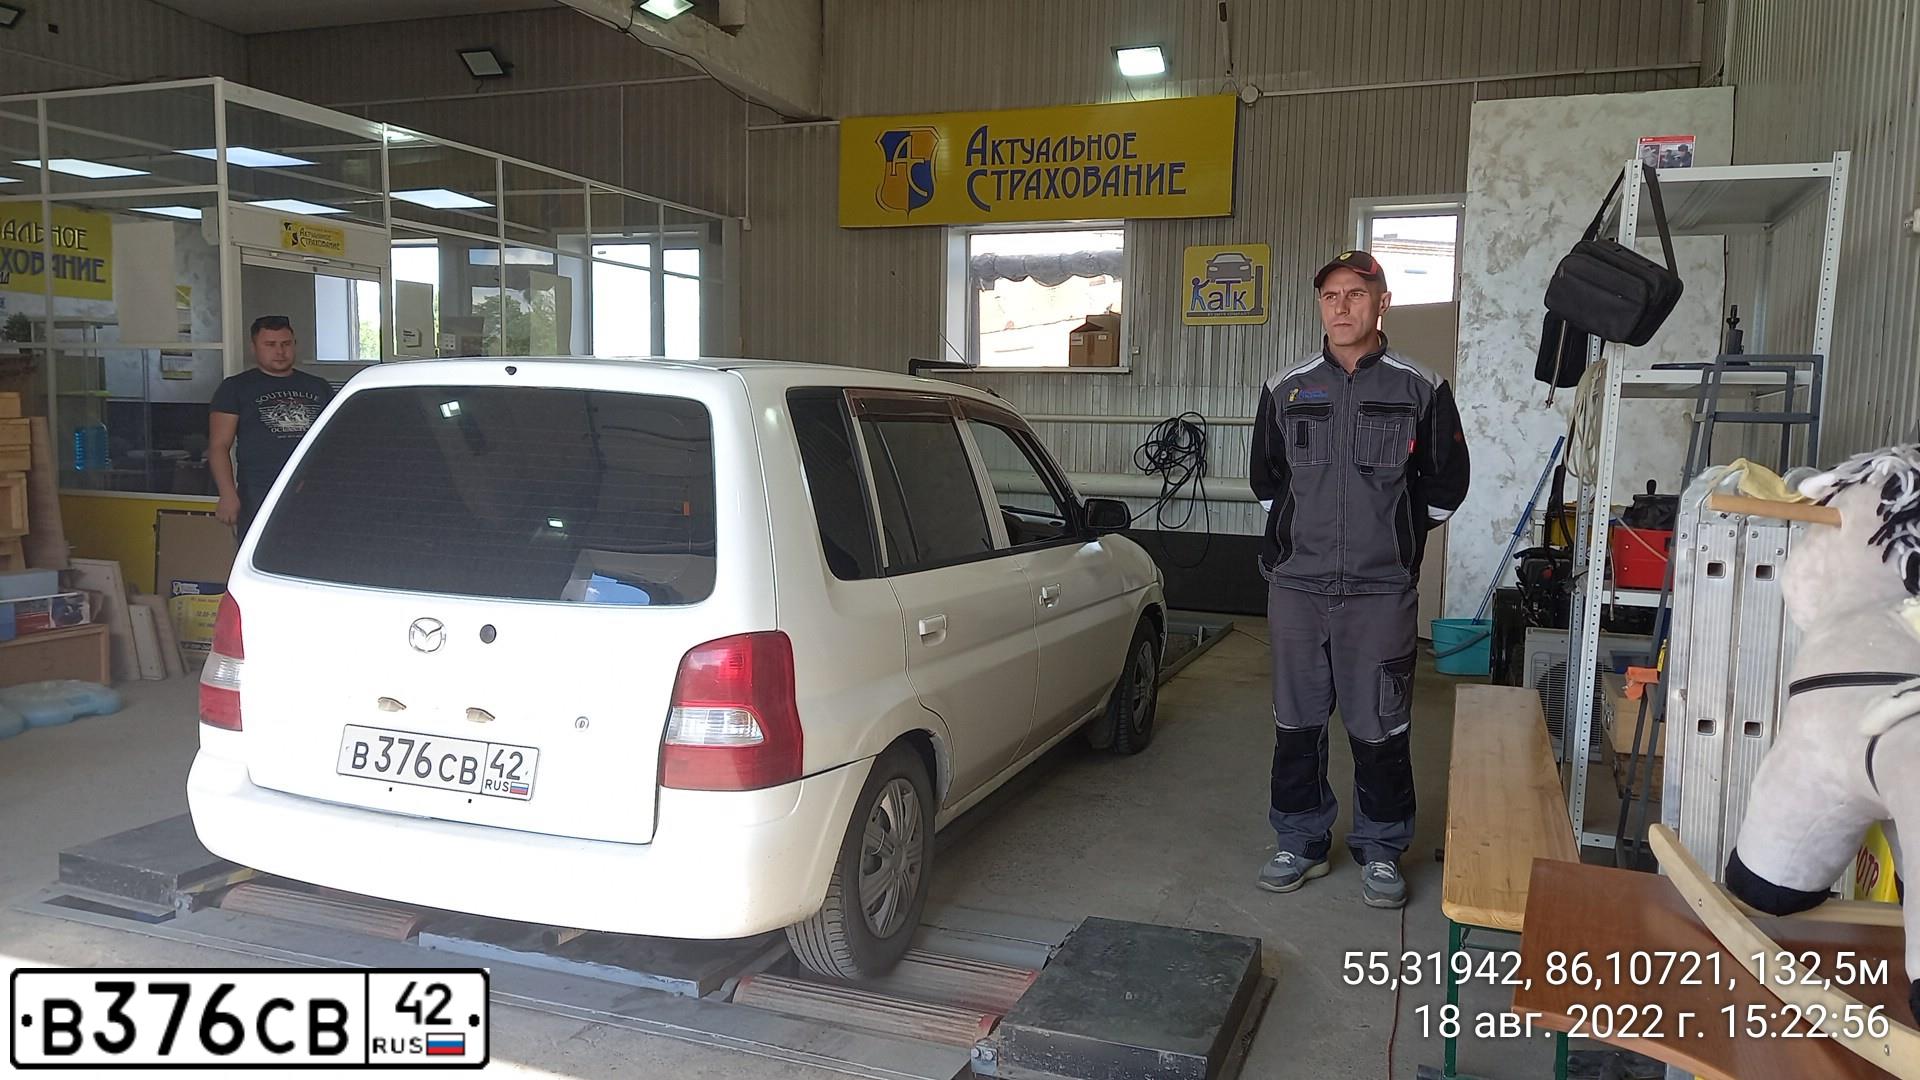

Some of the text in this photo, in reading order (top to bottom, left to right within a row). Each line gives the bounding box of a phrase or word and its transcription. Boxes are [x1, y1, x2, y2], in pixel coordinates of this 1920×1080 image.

[965, 125, 1137, 166] АКТУАЛЬНОЕ
[967, 162, 1186, 212] СТРАХОВАНИЕ
[351, 735, 478, 785] В376СВ
[490, 748, 524, 781] 42
[484, 779, 510, 792] RUS
